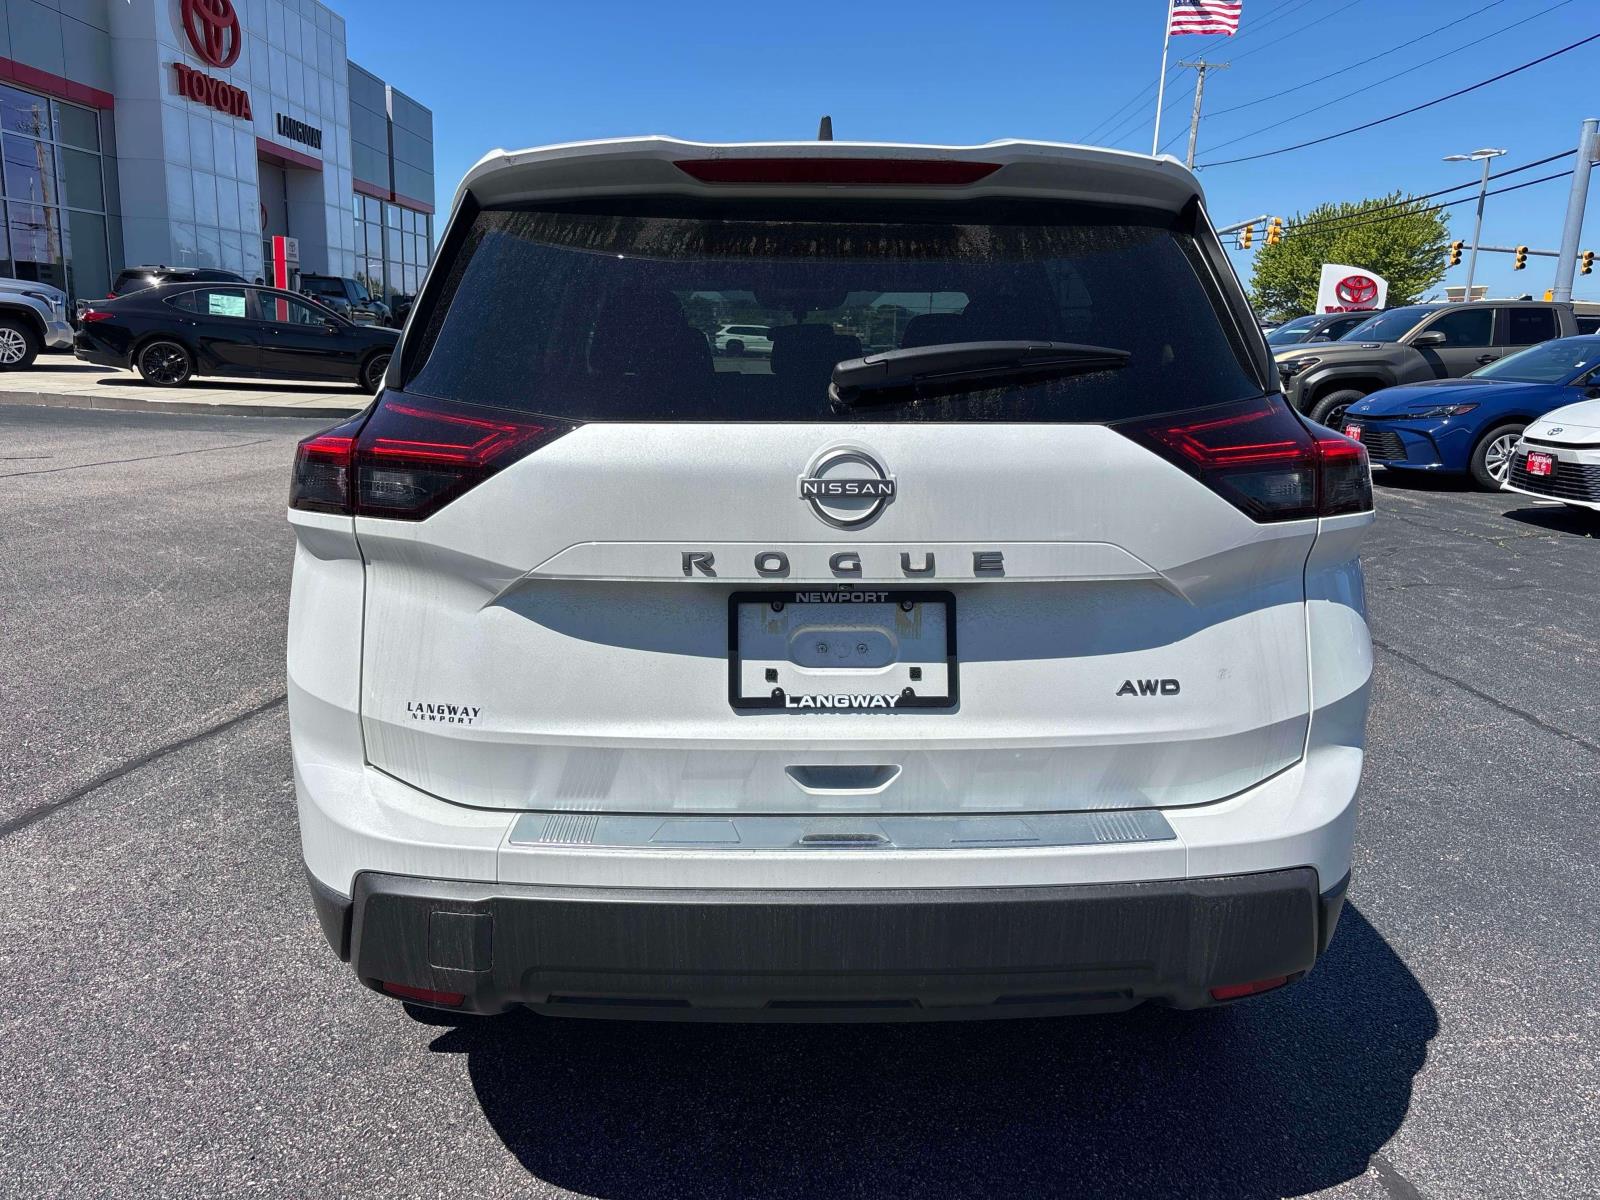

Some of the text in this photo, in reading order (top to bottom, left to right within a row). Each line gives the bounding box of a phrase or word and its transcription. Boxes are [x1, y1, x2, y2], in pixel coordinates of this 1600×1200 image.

[173, 62, 253, 121] TOYOTA
[276, 113, 322, 150] LANGWAY
[804, 482, 892, 494] NISSAN
[681, 551, 1006, 578] ROGUE
[795, 592, 889, 603] NEWPORT
[1115, 678, 1181, 697] AWD
[407, 701, 480, 717] LANGWAY
[785, 694, 900, 708] LANGWAY
[412, 712, 474, 724] NEWPORT
